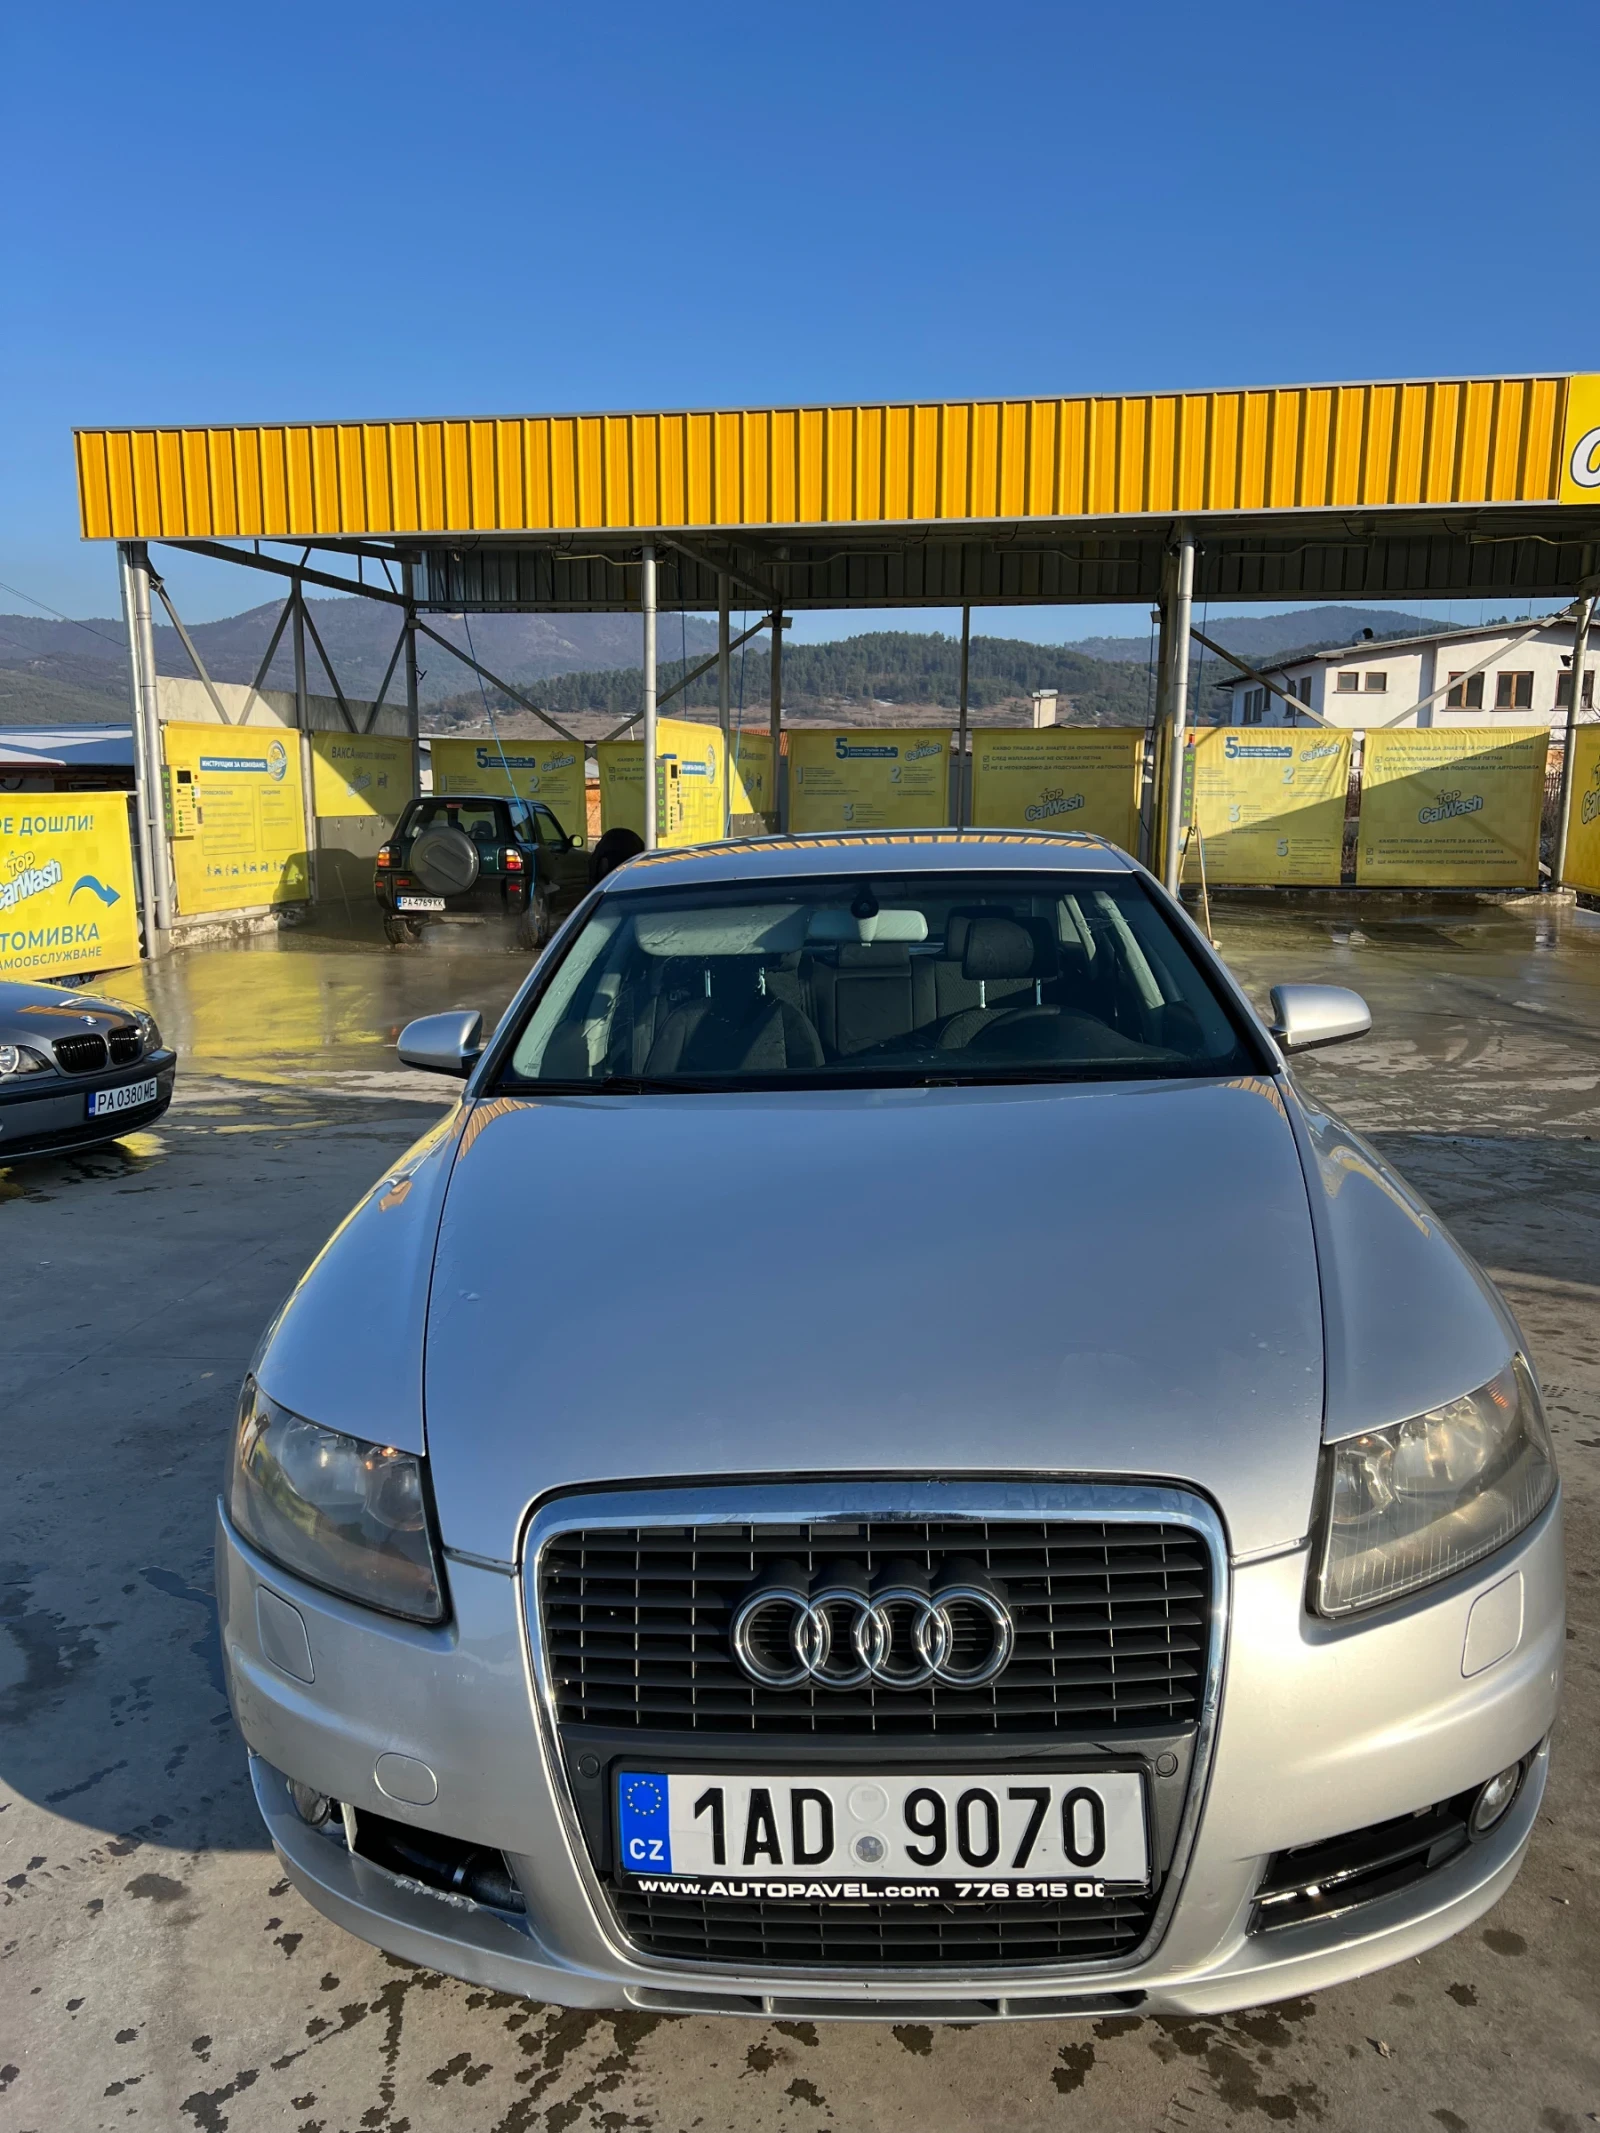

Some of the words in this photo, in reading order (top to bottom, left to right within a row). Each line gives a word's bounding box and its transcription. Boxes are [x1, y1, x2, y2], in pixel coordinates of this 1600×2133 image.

[332, 746, 354, 759] ВАКСА
[476, 748, 488, 768] 5
[836, 737, 848, 759] 5
[905, 743, 943, 761] CarWash
[1225, 737, 1239, 758] 5
[1299, 743, 1340, 762] CarWash
[1183, 753, 1195, 818] ЖЕТОНИ
[1282, 766, 1295, 784] 2
[161, 771, 173, 830] ЖЕТОНИ
[656, 766, 666, 828] ЖЕТОНИ
[1041, 788, 1064, 803] TOP
[1436, 790, 1461, 805] TOP
[1025, 793, 1085, 822] CarWash
[1229, 804, 1241, 822] 3
[1419, 795, 1483, 824] CarWash
[20, 815, 94, 836] ДОШЛИ!
[1276, 838, 1289, 857] 5
[7, 851, 35, 877] TOP
[402, 898, 412, 906] PA
[413, 898, 433, 907] 4769
[433, 899, 443, 907] KK
[97, 1092, 114, 1112] PA
[117, 1085, 143, 1107] 0380
[144, 1080, 155, 1100] ME
[694, 1787, 835, 1865] 1AD
[904, 1786, 1106, 1868] 9070
[629, 1838, 664, 1861] CZ
[638, 1880, 940, 1898] www.AUTOPAVEL.com
[955, 1882, 1010, 1898] 776
[1016, 1882, 1069, 1898] 815
